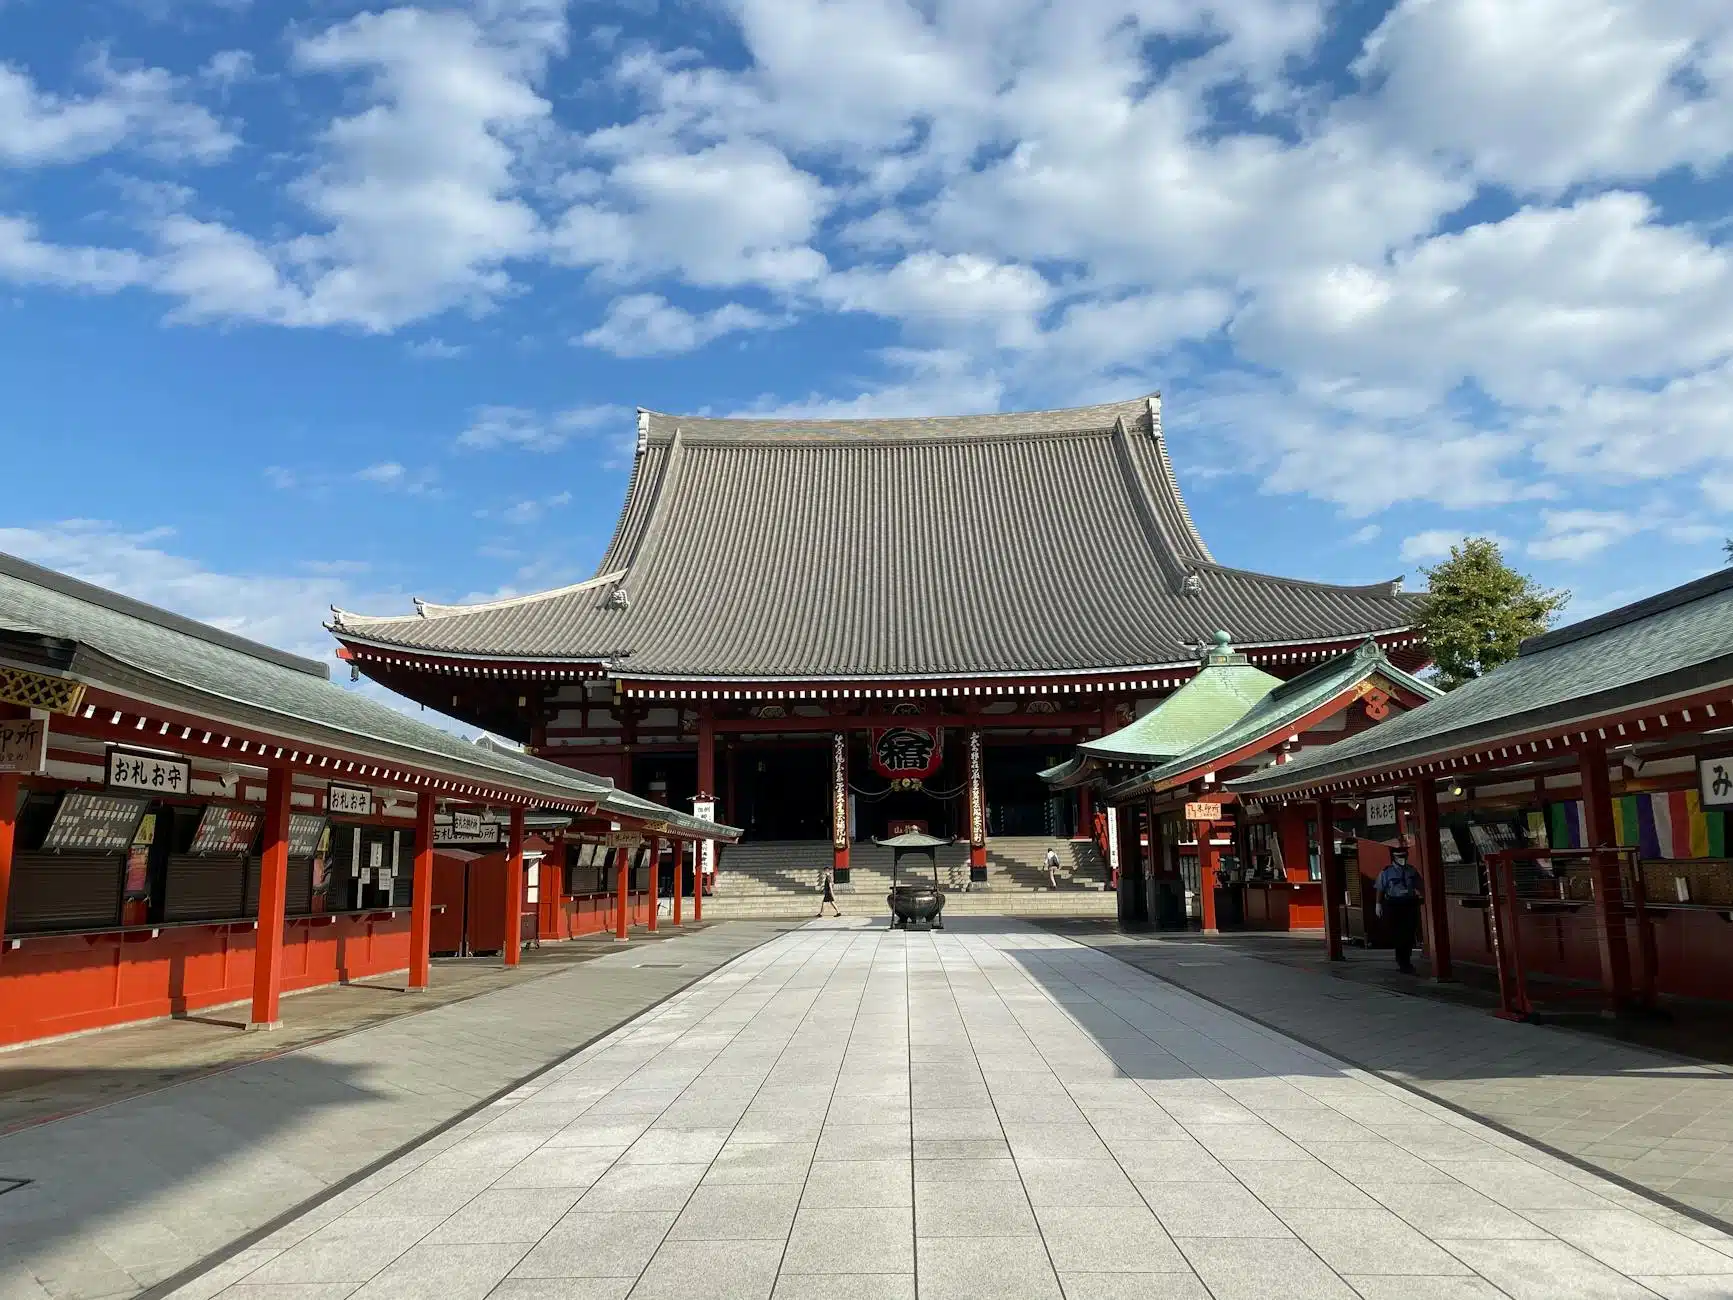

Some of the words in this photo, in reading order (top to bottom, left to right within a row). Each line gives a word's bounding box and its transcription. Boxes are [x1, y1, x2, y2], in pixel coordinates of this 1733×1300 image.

[115, 758, 182, 790] お札お守
[331, 789, 367, 812] お札お守
